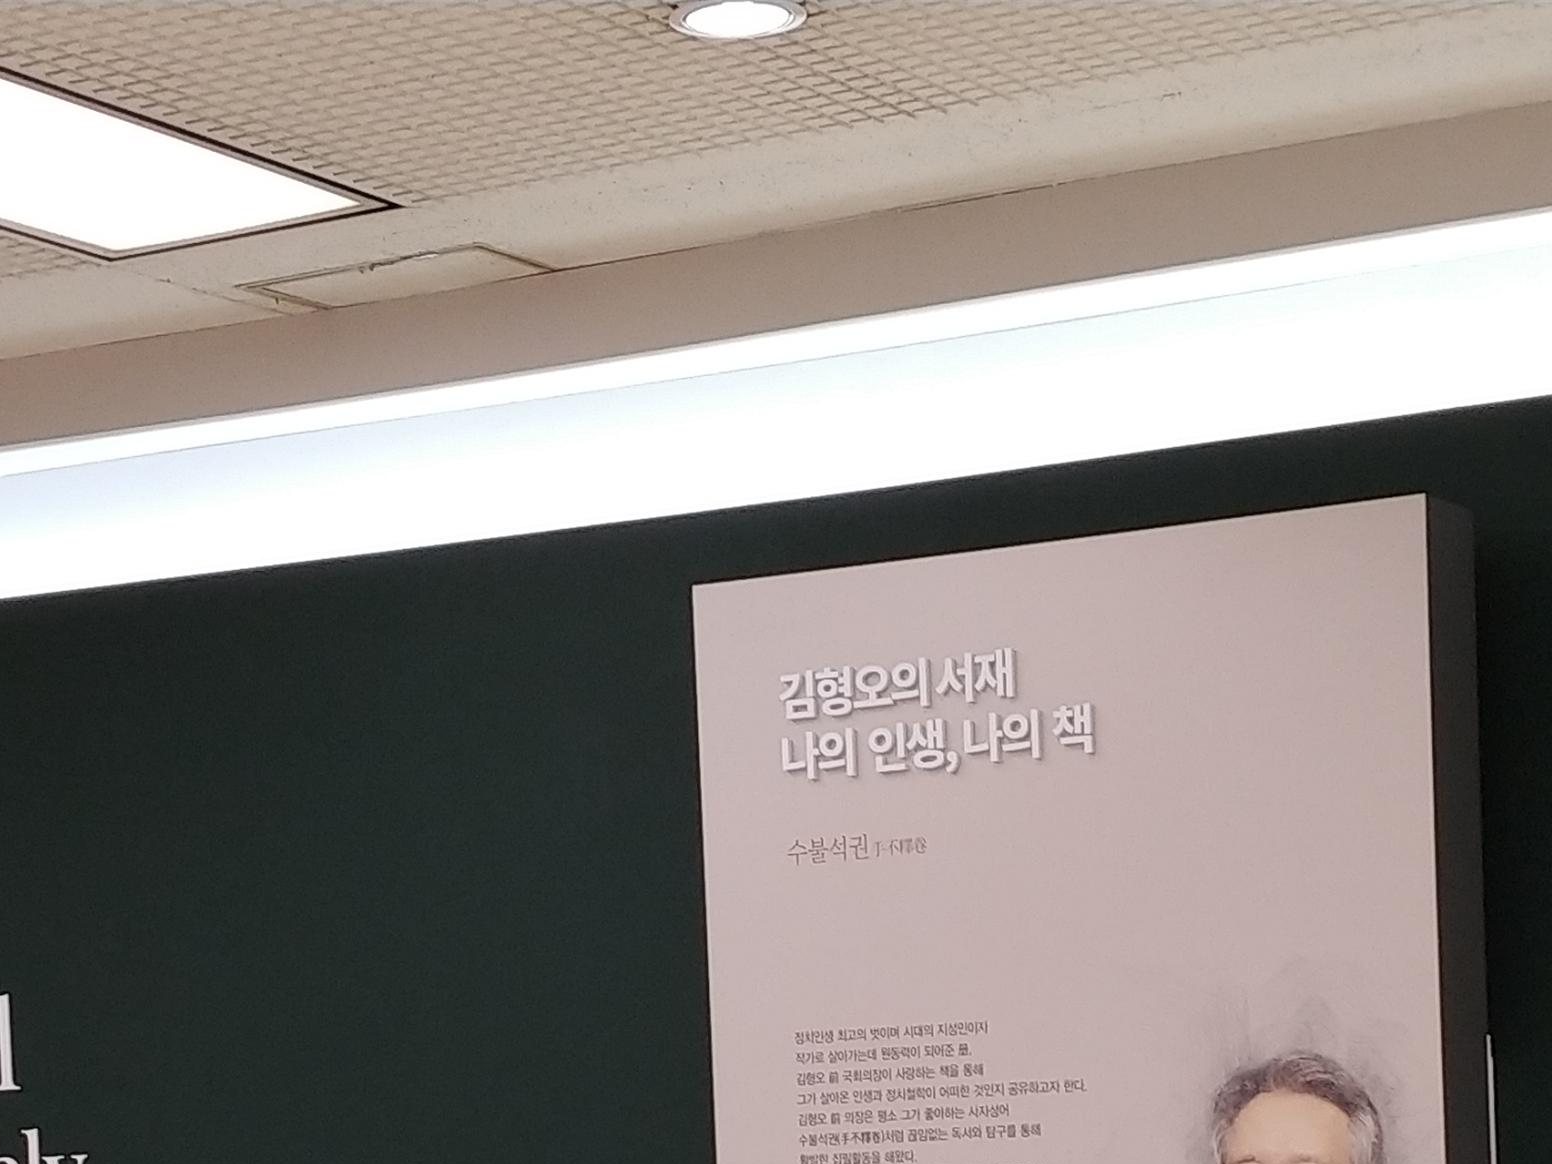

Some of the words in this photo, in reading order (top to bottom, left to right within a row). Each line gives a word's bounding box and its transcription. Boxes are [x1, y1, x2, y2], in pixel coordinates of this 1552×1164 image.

[779, 656, 931, 720] 김형오의
[935, 647, 1017, 703] 서재
[780, 727, 859, 781] 나의
[867, 718, 960, 774] 인생,
[962, 708, 1042, 763] 나의
[1052, 702, 1095, 754] 책
[786, 832, 869, 866] 수불석권
[838, 1028, 867, 1041] 최고의
[903, 1024, 934, 1038] 시대의
[795, 1051, 825, 1064] 작가로
[797, 1071, 825, 1086] 김형오
[842, 1068, 892, 1083] 국회의장이
[895, 1066, 936, 1080] 사랑하는
[940, 1064, 959, 1078] 책을
[963, 1063, 984, 1077] 통해
[797, 1092, 816, 1105] 그가
[820, 1090, 849, 1105] 살아온
[852, 1088, 882, 1103] 인생과
[974, 1082, 1004, 1097] 것인지
[1008, 1080, 1060, 1096] 공유하고자
[1064, 1079, 1088, 1093] 한다.
[799, 1112, 827, 1126] 김형오
[844, 1109, 873, 1124] 의장은
[877, 1109, 897, 1123] 평소
[900, 1108, 920, 1121] 그가
[924, 1106, 965, 1121] 좋아하는
[968, 1103, 1009, 1118] 사자성어
[952, 1125, 982, 1140] 독서와
[1021, 1123, 1041, 1138] 통해
